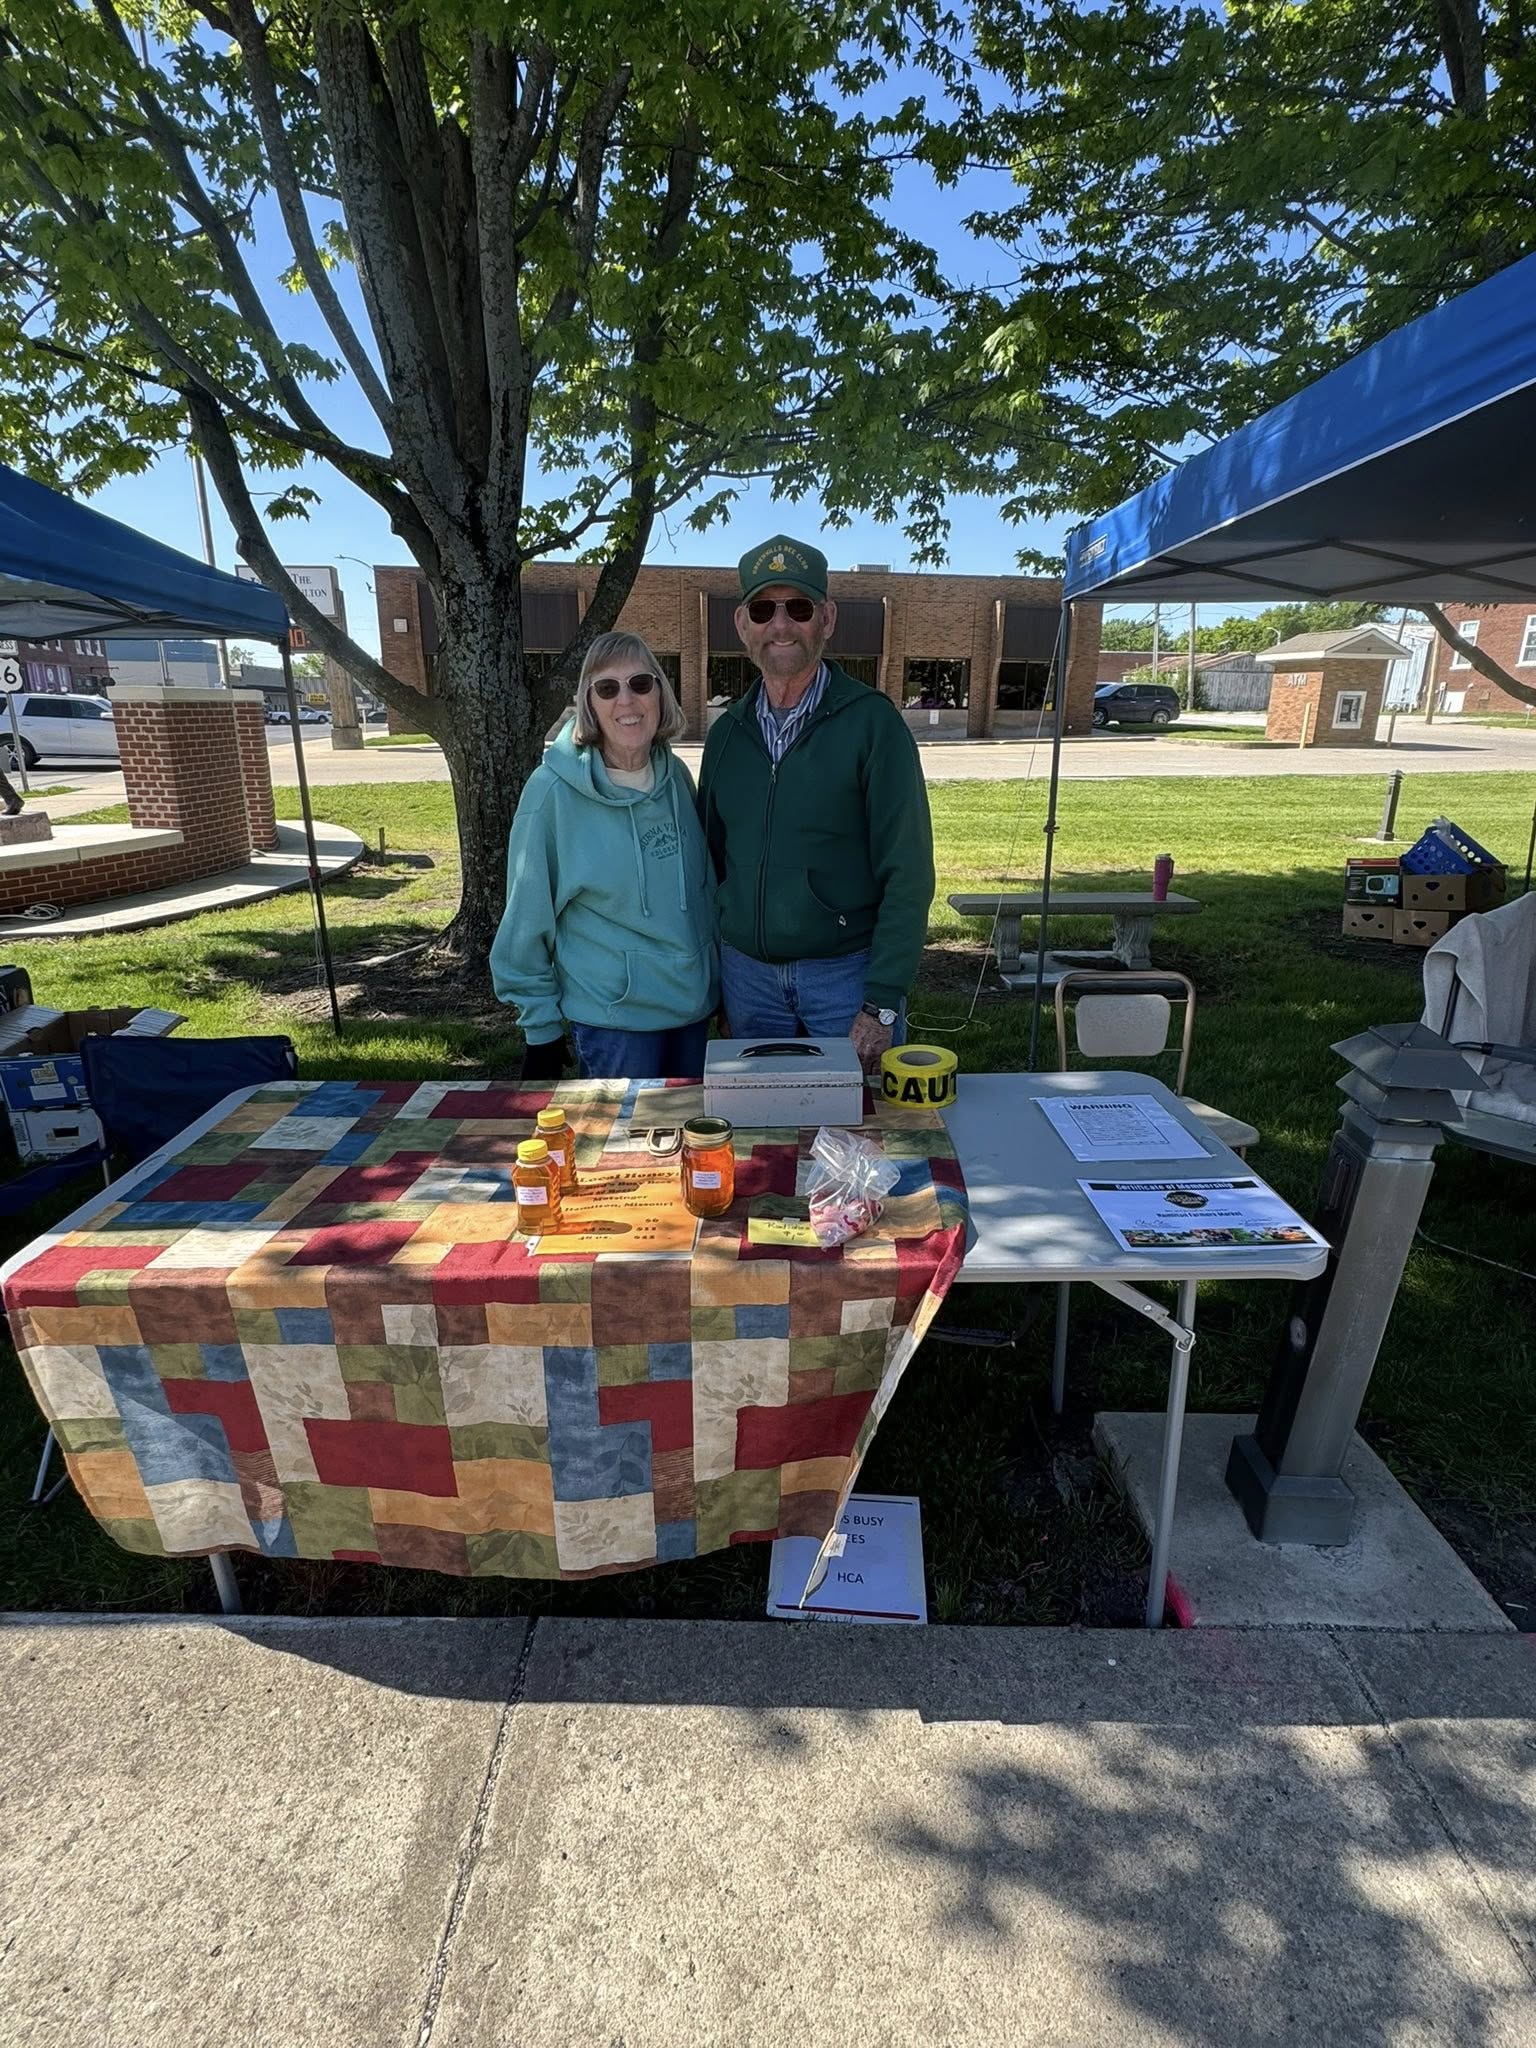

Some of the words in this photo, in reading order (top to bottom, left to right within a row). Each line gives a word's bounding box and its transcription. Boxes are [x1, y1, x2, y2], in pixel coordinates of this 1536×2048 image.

[783, 545, 797, 555] BEE
[291, 573, 312, 585] THE
[302, 588, 328, 597] LTON
[0, 666, 17, 684] 6
[1287, 672, 1308, 687] ATM
[1069, 1103, 1133, 1111] WARNING
[580, 1173, 621, 1183] Local
[1114, 1183, 1165, 1192] Certificate
[1176, 1181, 1234, 1190] Membership
[840, 1514, 850, 1525] S
[853, 1515, 884, 1526] BUSY
[837, 1572, 864, 1584] HCA
